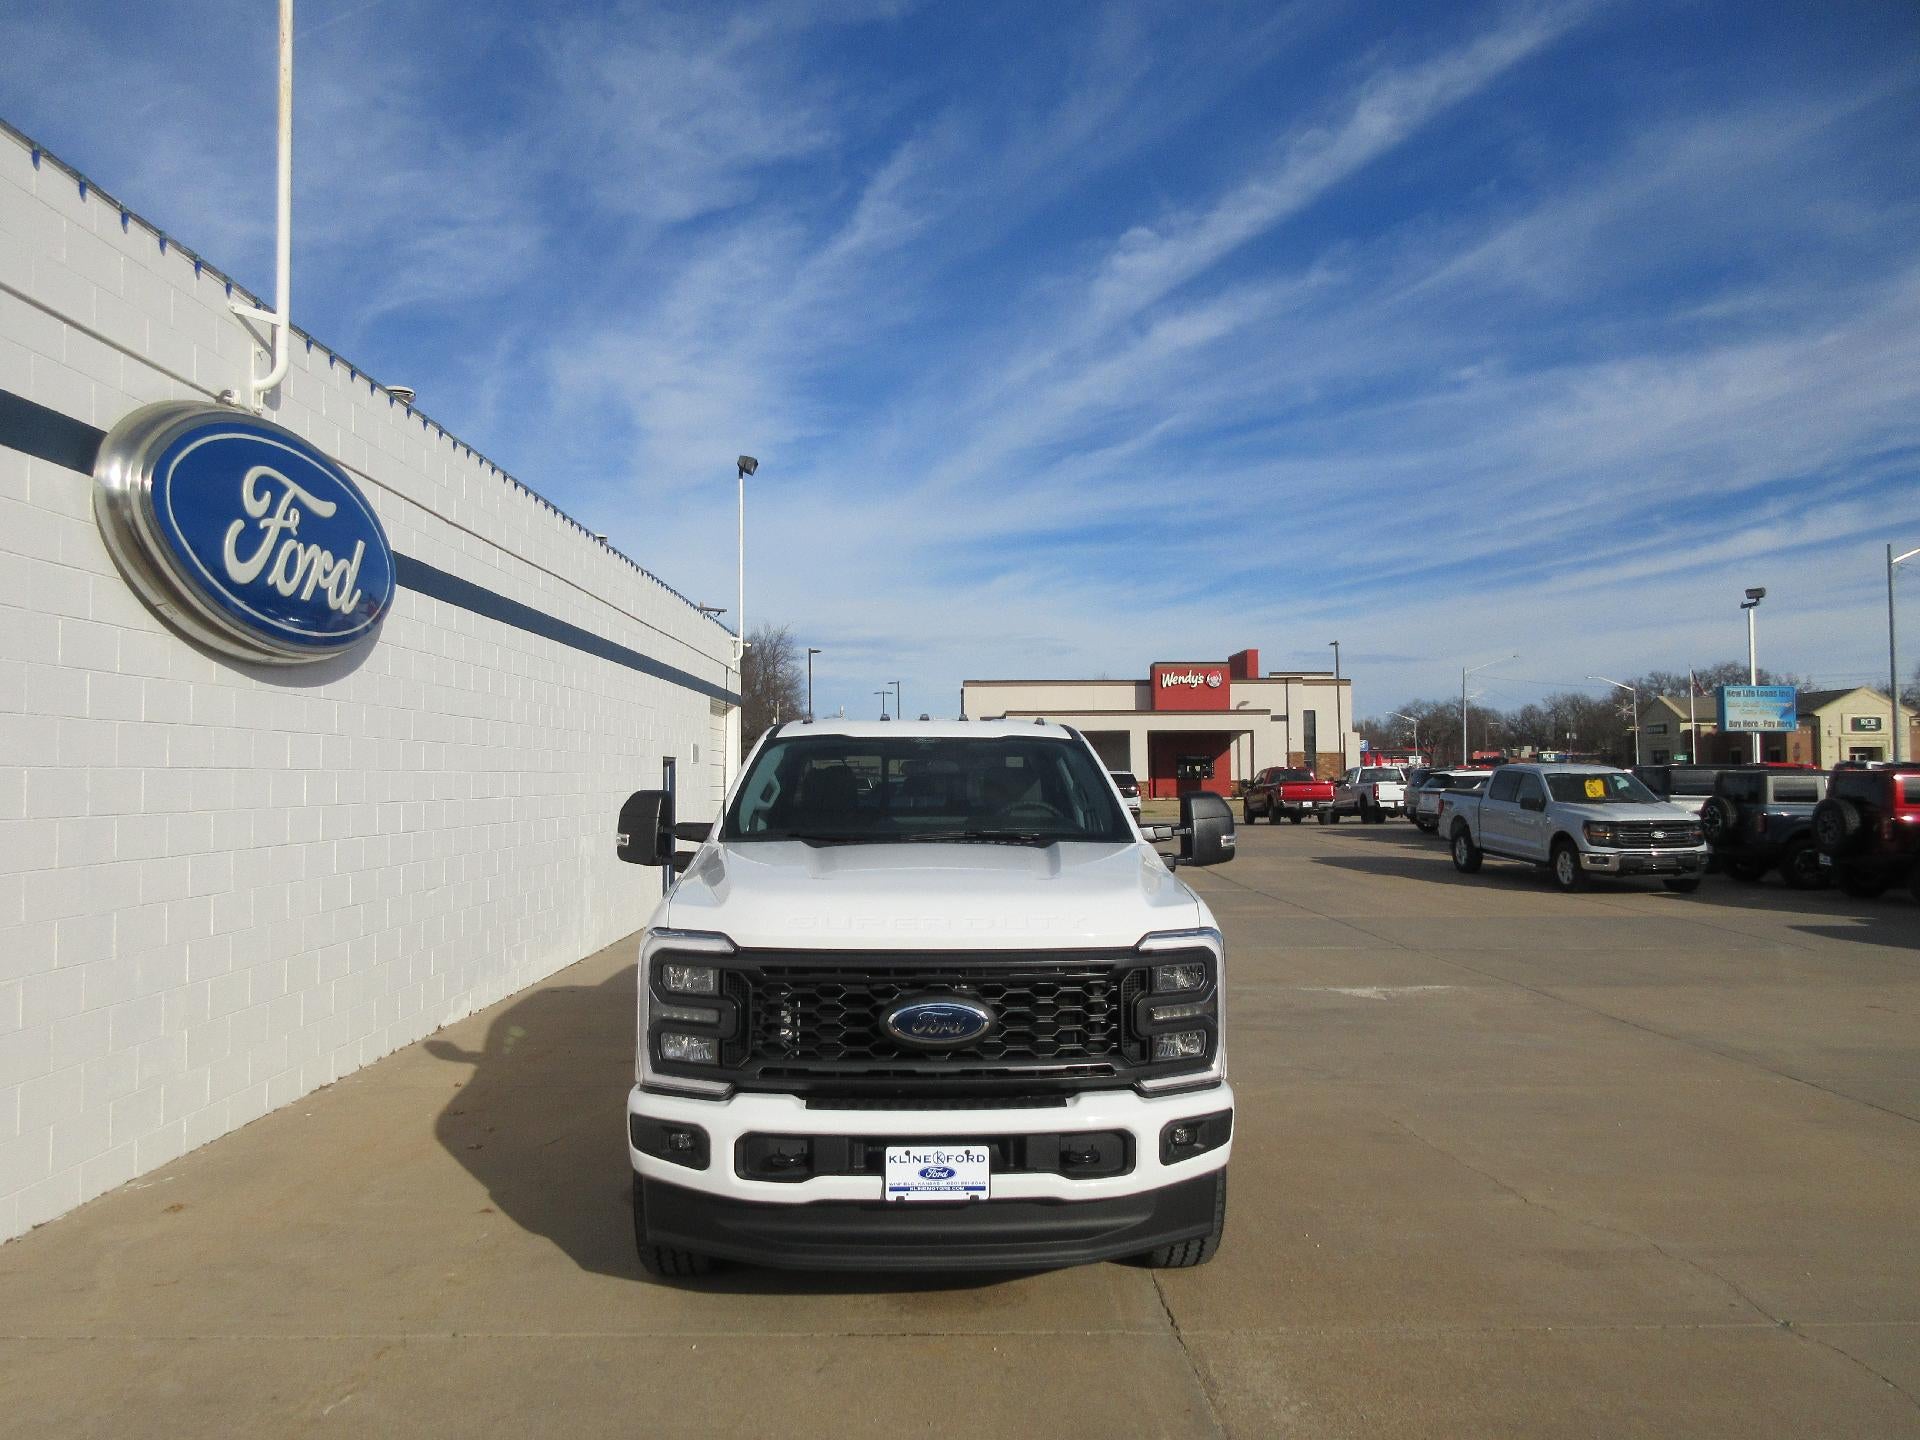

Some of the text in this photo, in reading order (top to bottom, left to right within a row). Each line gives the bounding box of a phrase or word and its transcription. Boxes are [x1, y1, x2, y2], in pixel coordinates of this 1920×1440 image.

[224, 465, 366, 615] Ford
[1162, 669, 1205, 688] Wendy's
[1743, 720, 1758, 728] Here
[911, 1011, 966, 1034] Ford
[889, 1153, 931, 1164] KLINE
[947, 1153, 986, 1164] FORD
[925, 1167, 949, 1178] Ford
